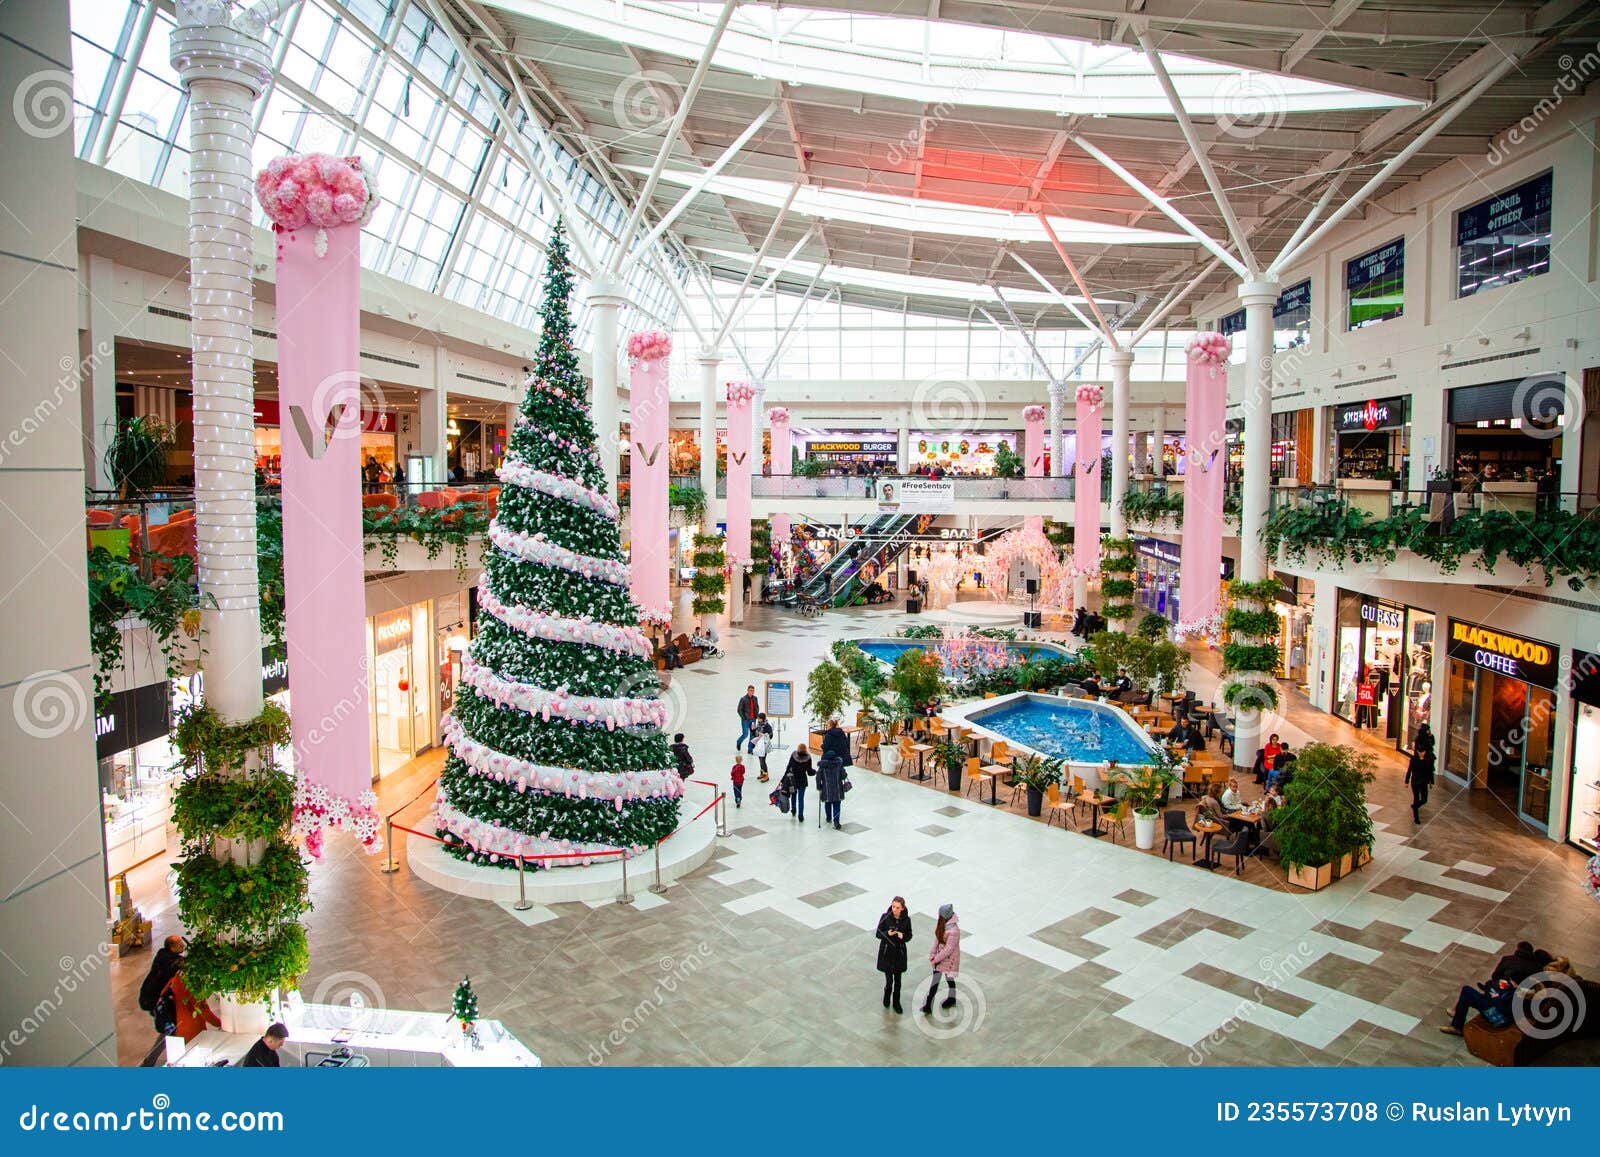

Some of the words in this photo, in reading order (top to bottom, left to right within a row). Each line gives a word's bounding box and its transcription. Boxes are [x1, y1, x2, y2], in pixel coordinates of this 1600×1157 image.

[1490, 193, 1521, 216] КОРОЛЬ
[1487, 207, 1523, 231] ФІТНЕСУ
[1369, 260, 1386, 279] KING
[811, 443, 860, 451] BLACKWOOD
[863, 443, 892, 451] BURGER
[901, 481, 952, 490] #FreeSentsov
[1361, 604, 1400, 629] GUESS
[1453, 622, 1549, 666] BLACKWOOD
[1475, 650, 1518, 675] COFFEE
